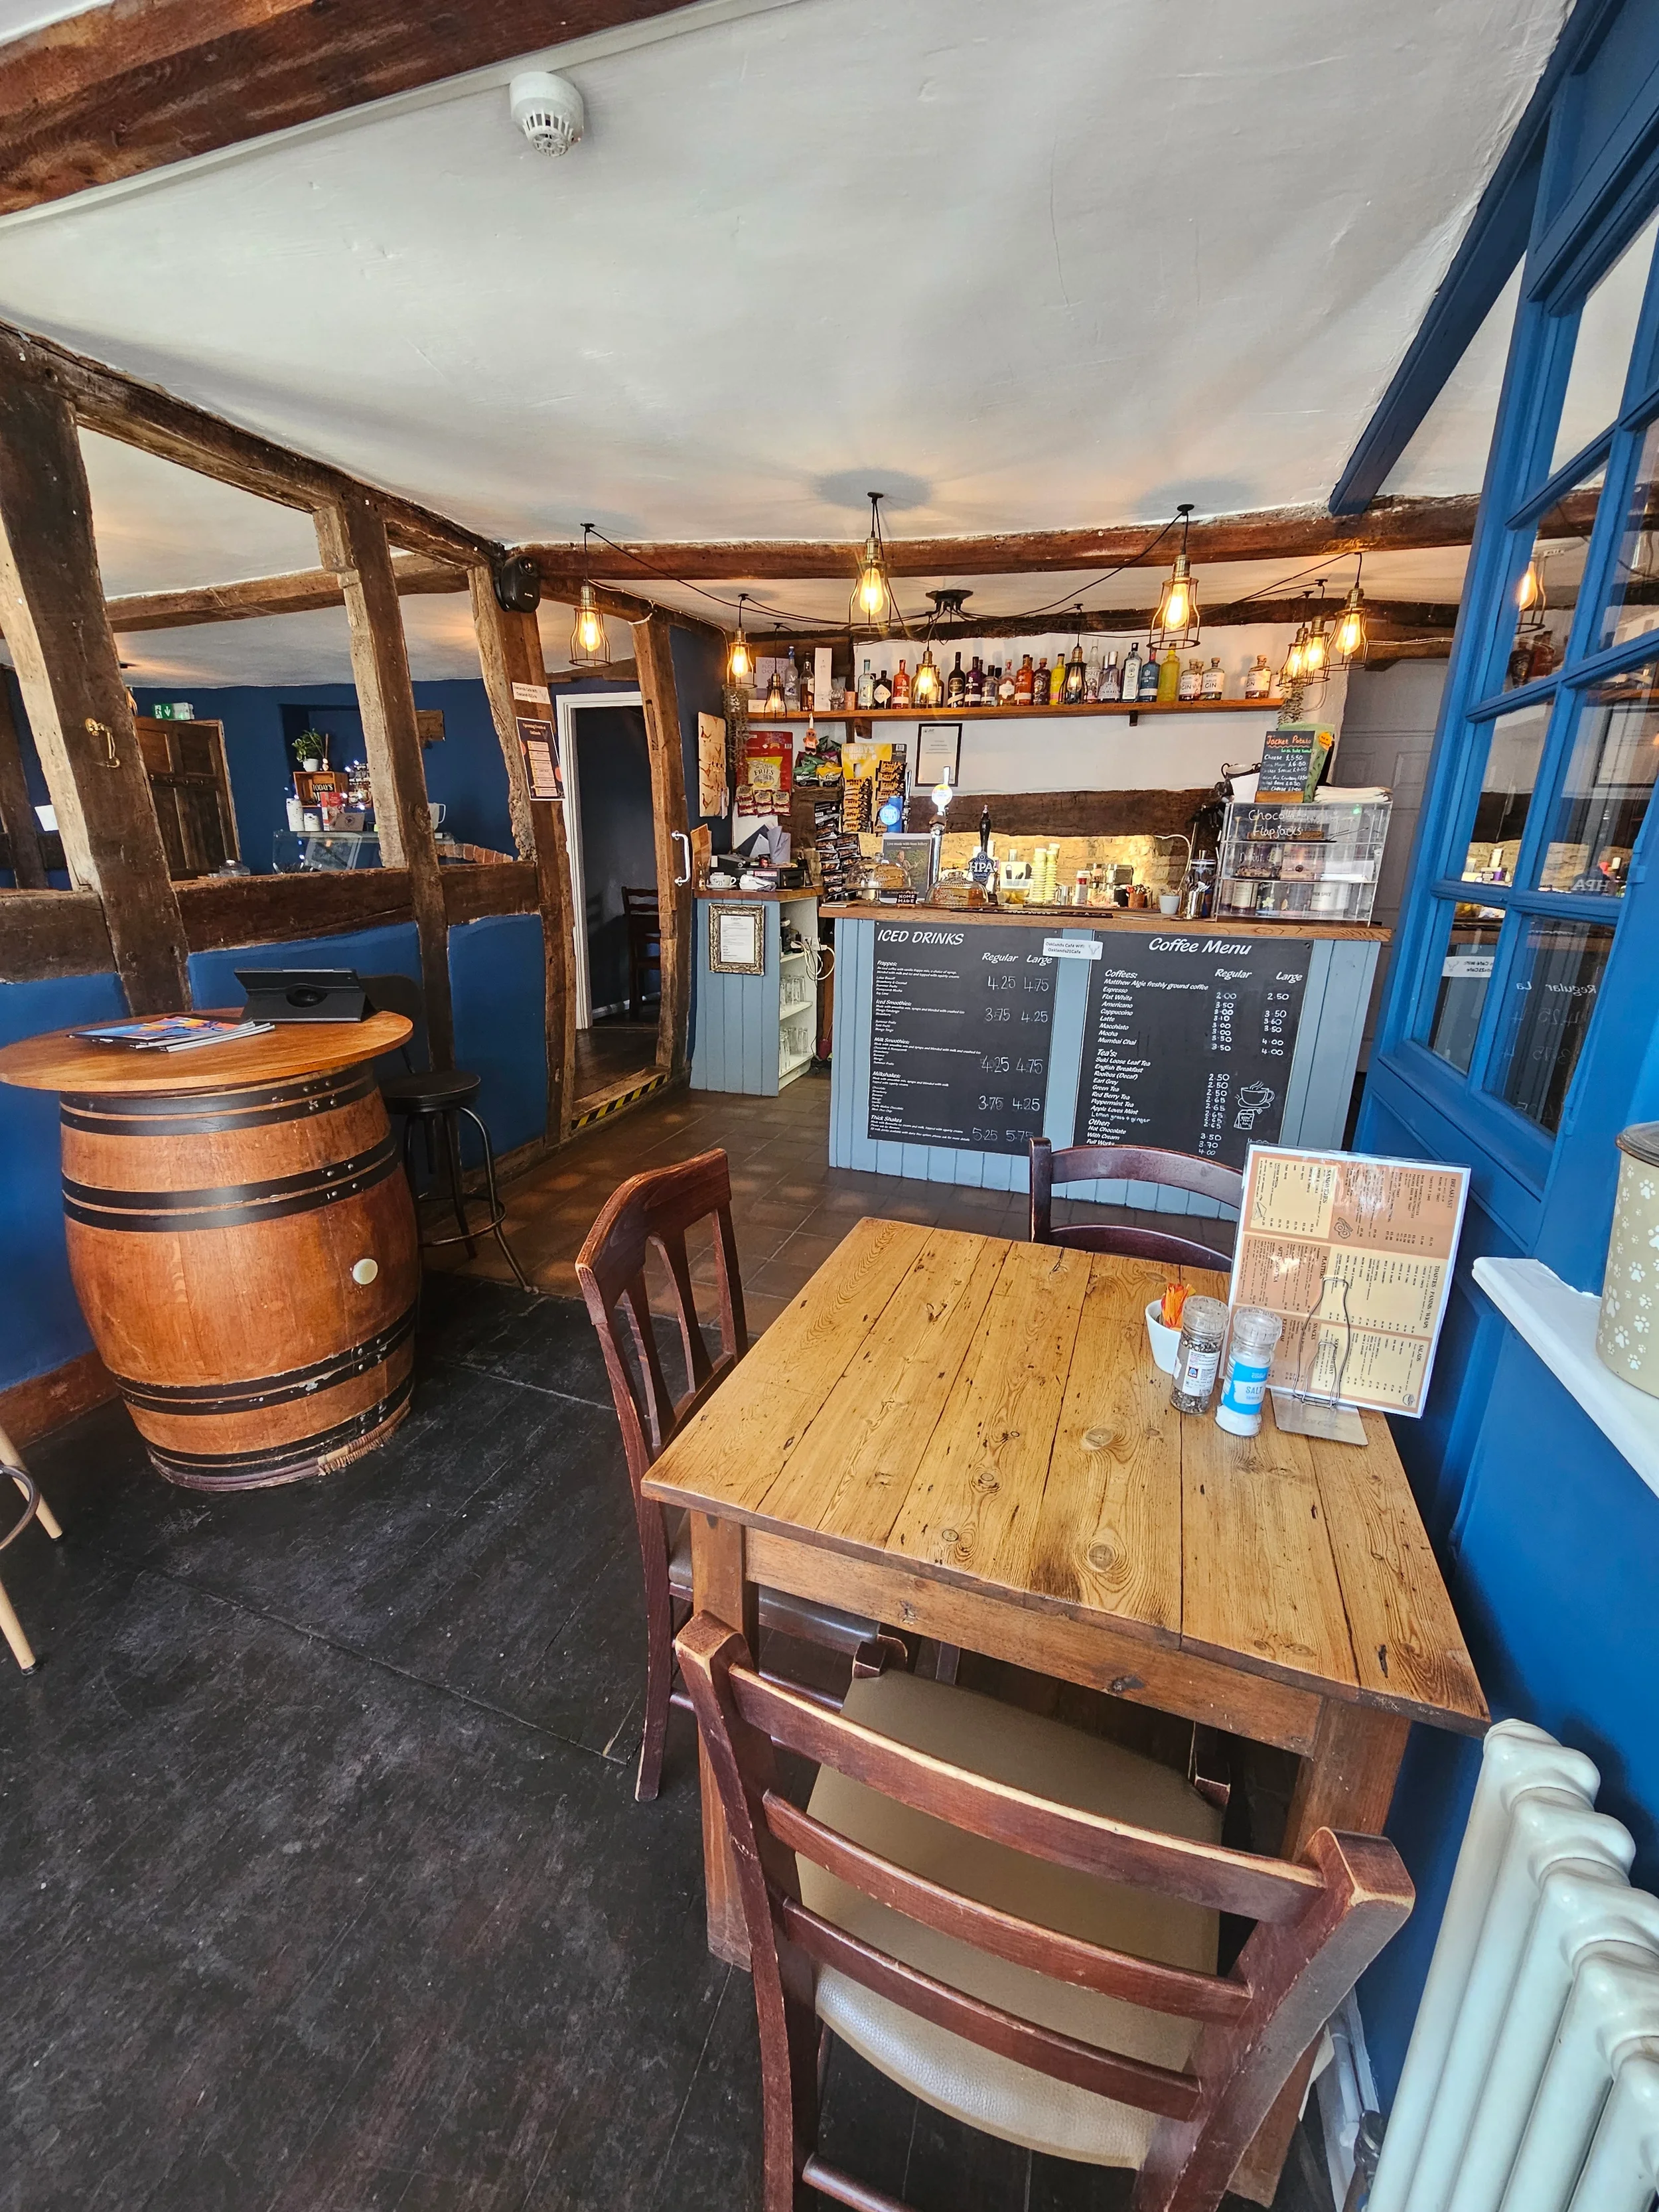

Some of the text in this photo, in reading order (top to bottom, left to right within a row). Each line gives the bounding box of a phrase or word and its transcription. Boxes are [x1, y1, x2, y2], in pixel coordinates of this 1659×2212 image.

[1267, 735, 1289, 745] Jacket
[1292, 735, 1312, 744] Potato
[969, 862, 994, 872] HPA
[877, 929, 964, 945] ICED DRINKS
[1149, 937, 1252, 955] Coffee Menu
[982, 952, 1053, 966] Regular Large
[1105, 970, 1138, 979] Coffees:
[1214, 969, 1303, 984] Regular Large
[987, 976, 1049, 992] 4.25 4.75
[1104, 978, 1131, 987] Matthew
[1131, 980, 1147, 988] Algie
[985, 1007, 1048, 1023] 3.75 4.25
[1098, 1049, 1118, 1057] Tea's:
[981, 1055, 1043, 1074] 4.25 4.75
[1013, 1098, 1041, 1111] 4.25
[1091, 1098, 1123, 1107] Peppermint
[1205, 1103, 1226, 1112] 2.65
[1205, 1110, 1224, 1119] 2.65
[1088, 1118, 1111, 1127] Other:
[972, 1128, 998, 1142] 5.25
[1099, 1126, 1127, 1135] Chocolate
[1447, 1178, 1457, 1209] BREAKFAST
[1319, 1256, 1328, 1280] PLATTERS
[1431, 1265, 1440, 1288] TOASTIES
[1423, 1312, 1432, 1329] WRAPS
